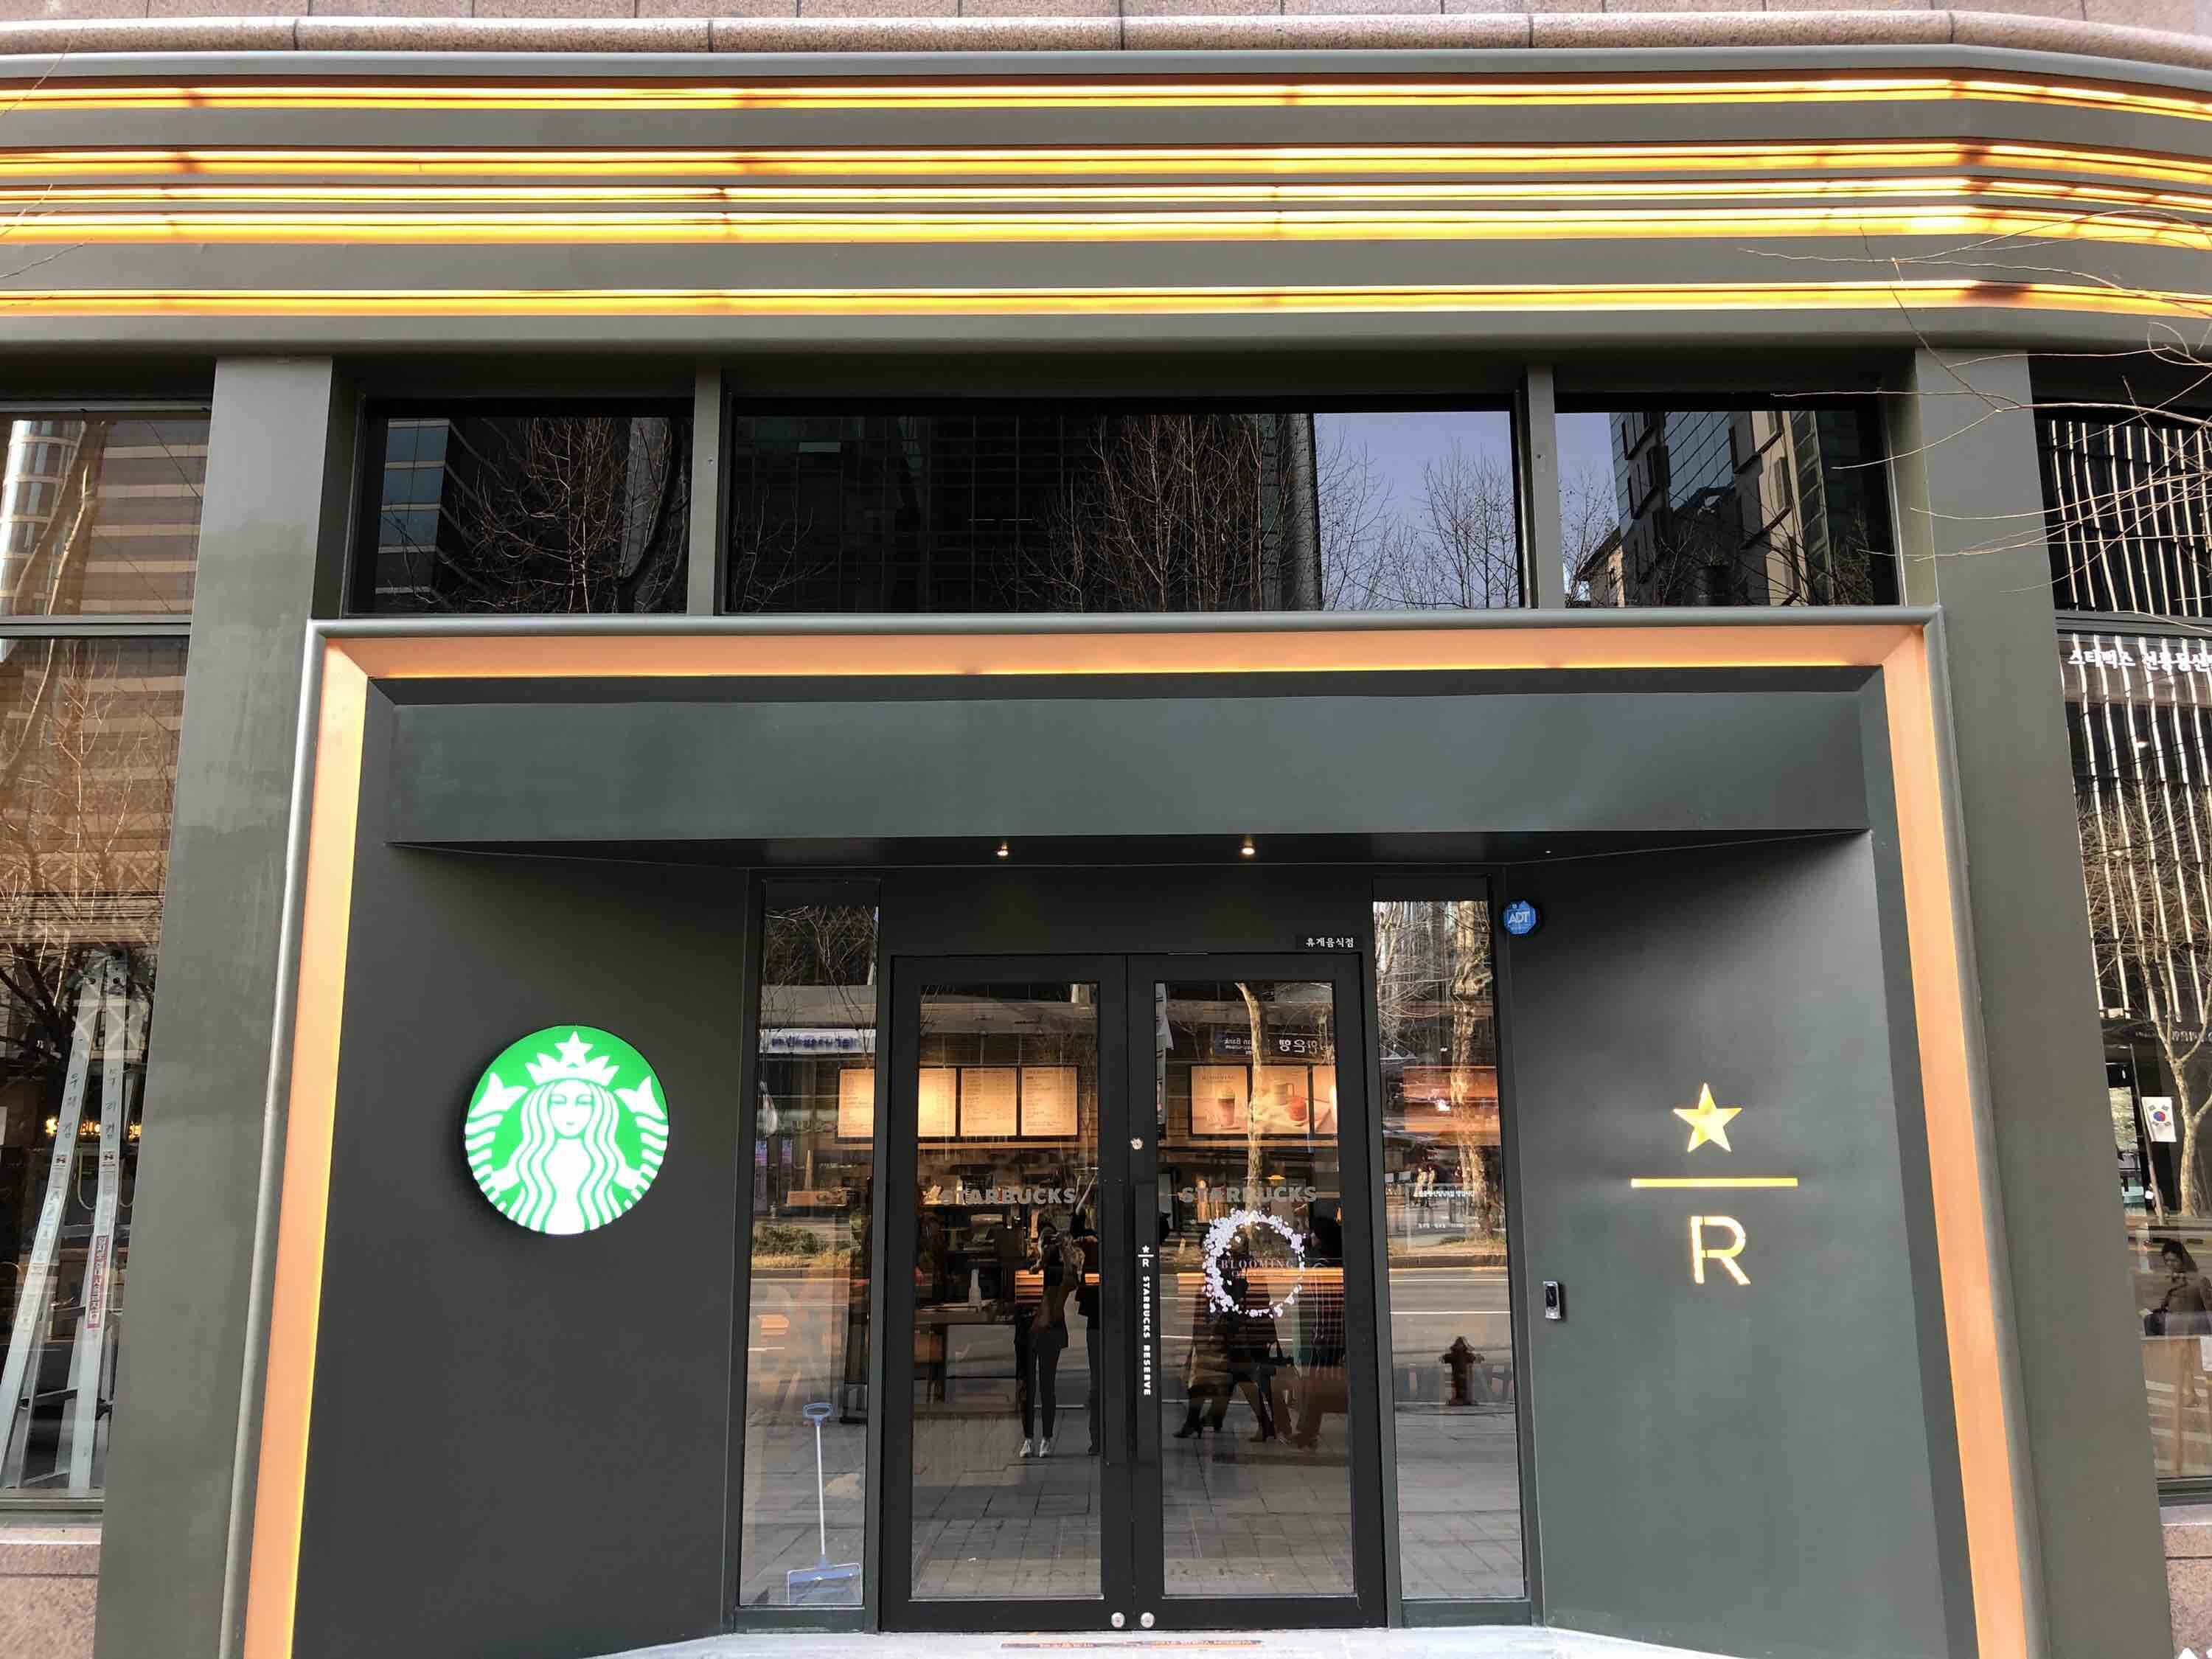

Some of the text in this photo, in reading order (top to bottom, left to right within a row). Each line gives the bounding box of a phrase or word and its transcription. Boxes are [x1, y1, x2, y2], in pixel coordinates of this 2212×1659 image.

[1509, 911, 1531, 923] ADT
[1305, 937, 1354, 948] 휴게음식점
[943, 1187, 1075, 1205] TARBUCKS
[1690, 1215, 1752, 1286] R
[1142, 1258, 1150, 1268] R
[1143, 1276, 1151, 1338] STARBUCKS
